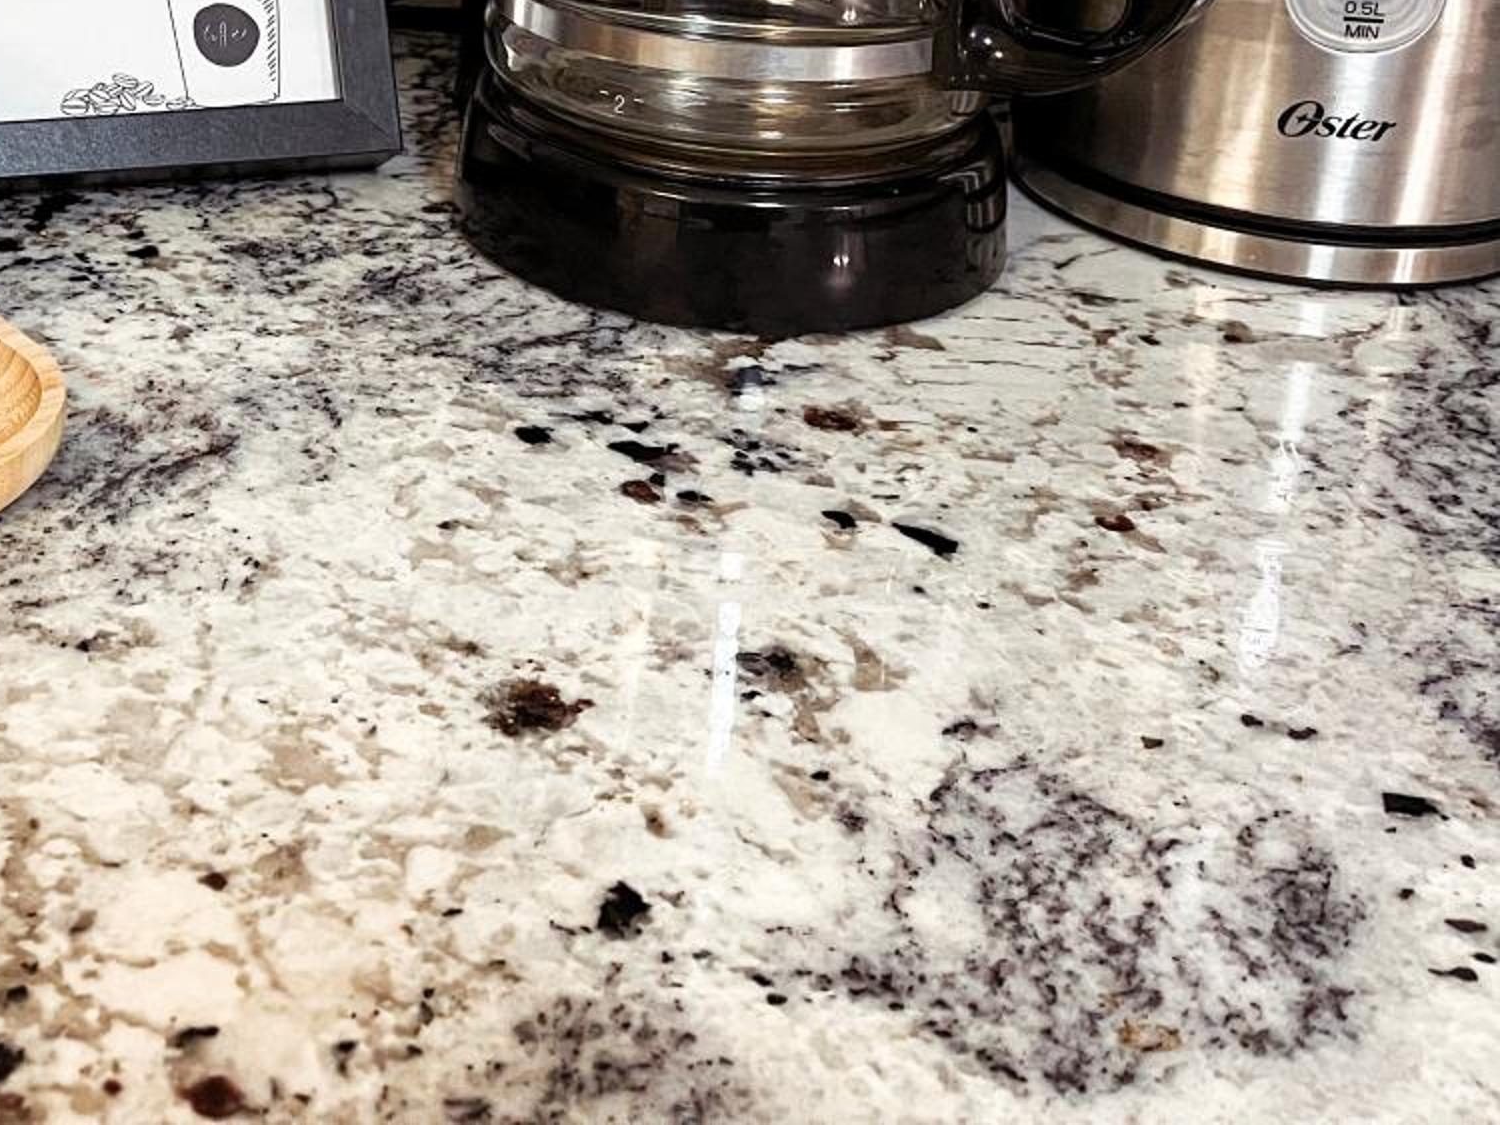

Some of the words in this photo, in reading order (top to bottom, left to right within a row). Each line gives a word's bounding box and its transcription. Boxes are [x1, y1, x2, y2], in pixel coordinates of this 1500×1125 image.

[1344, 24, 1380, 39] MIN
[613, 94, 625, 114] 2
[1277, 100, 1397, 142] Oster
